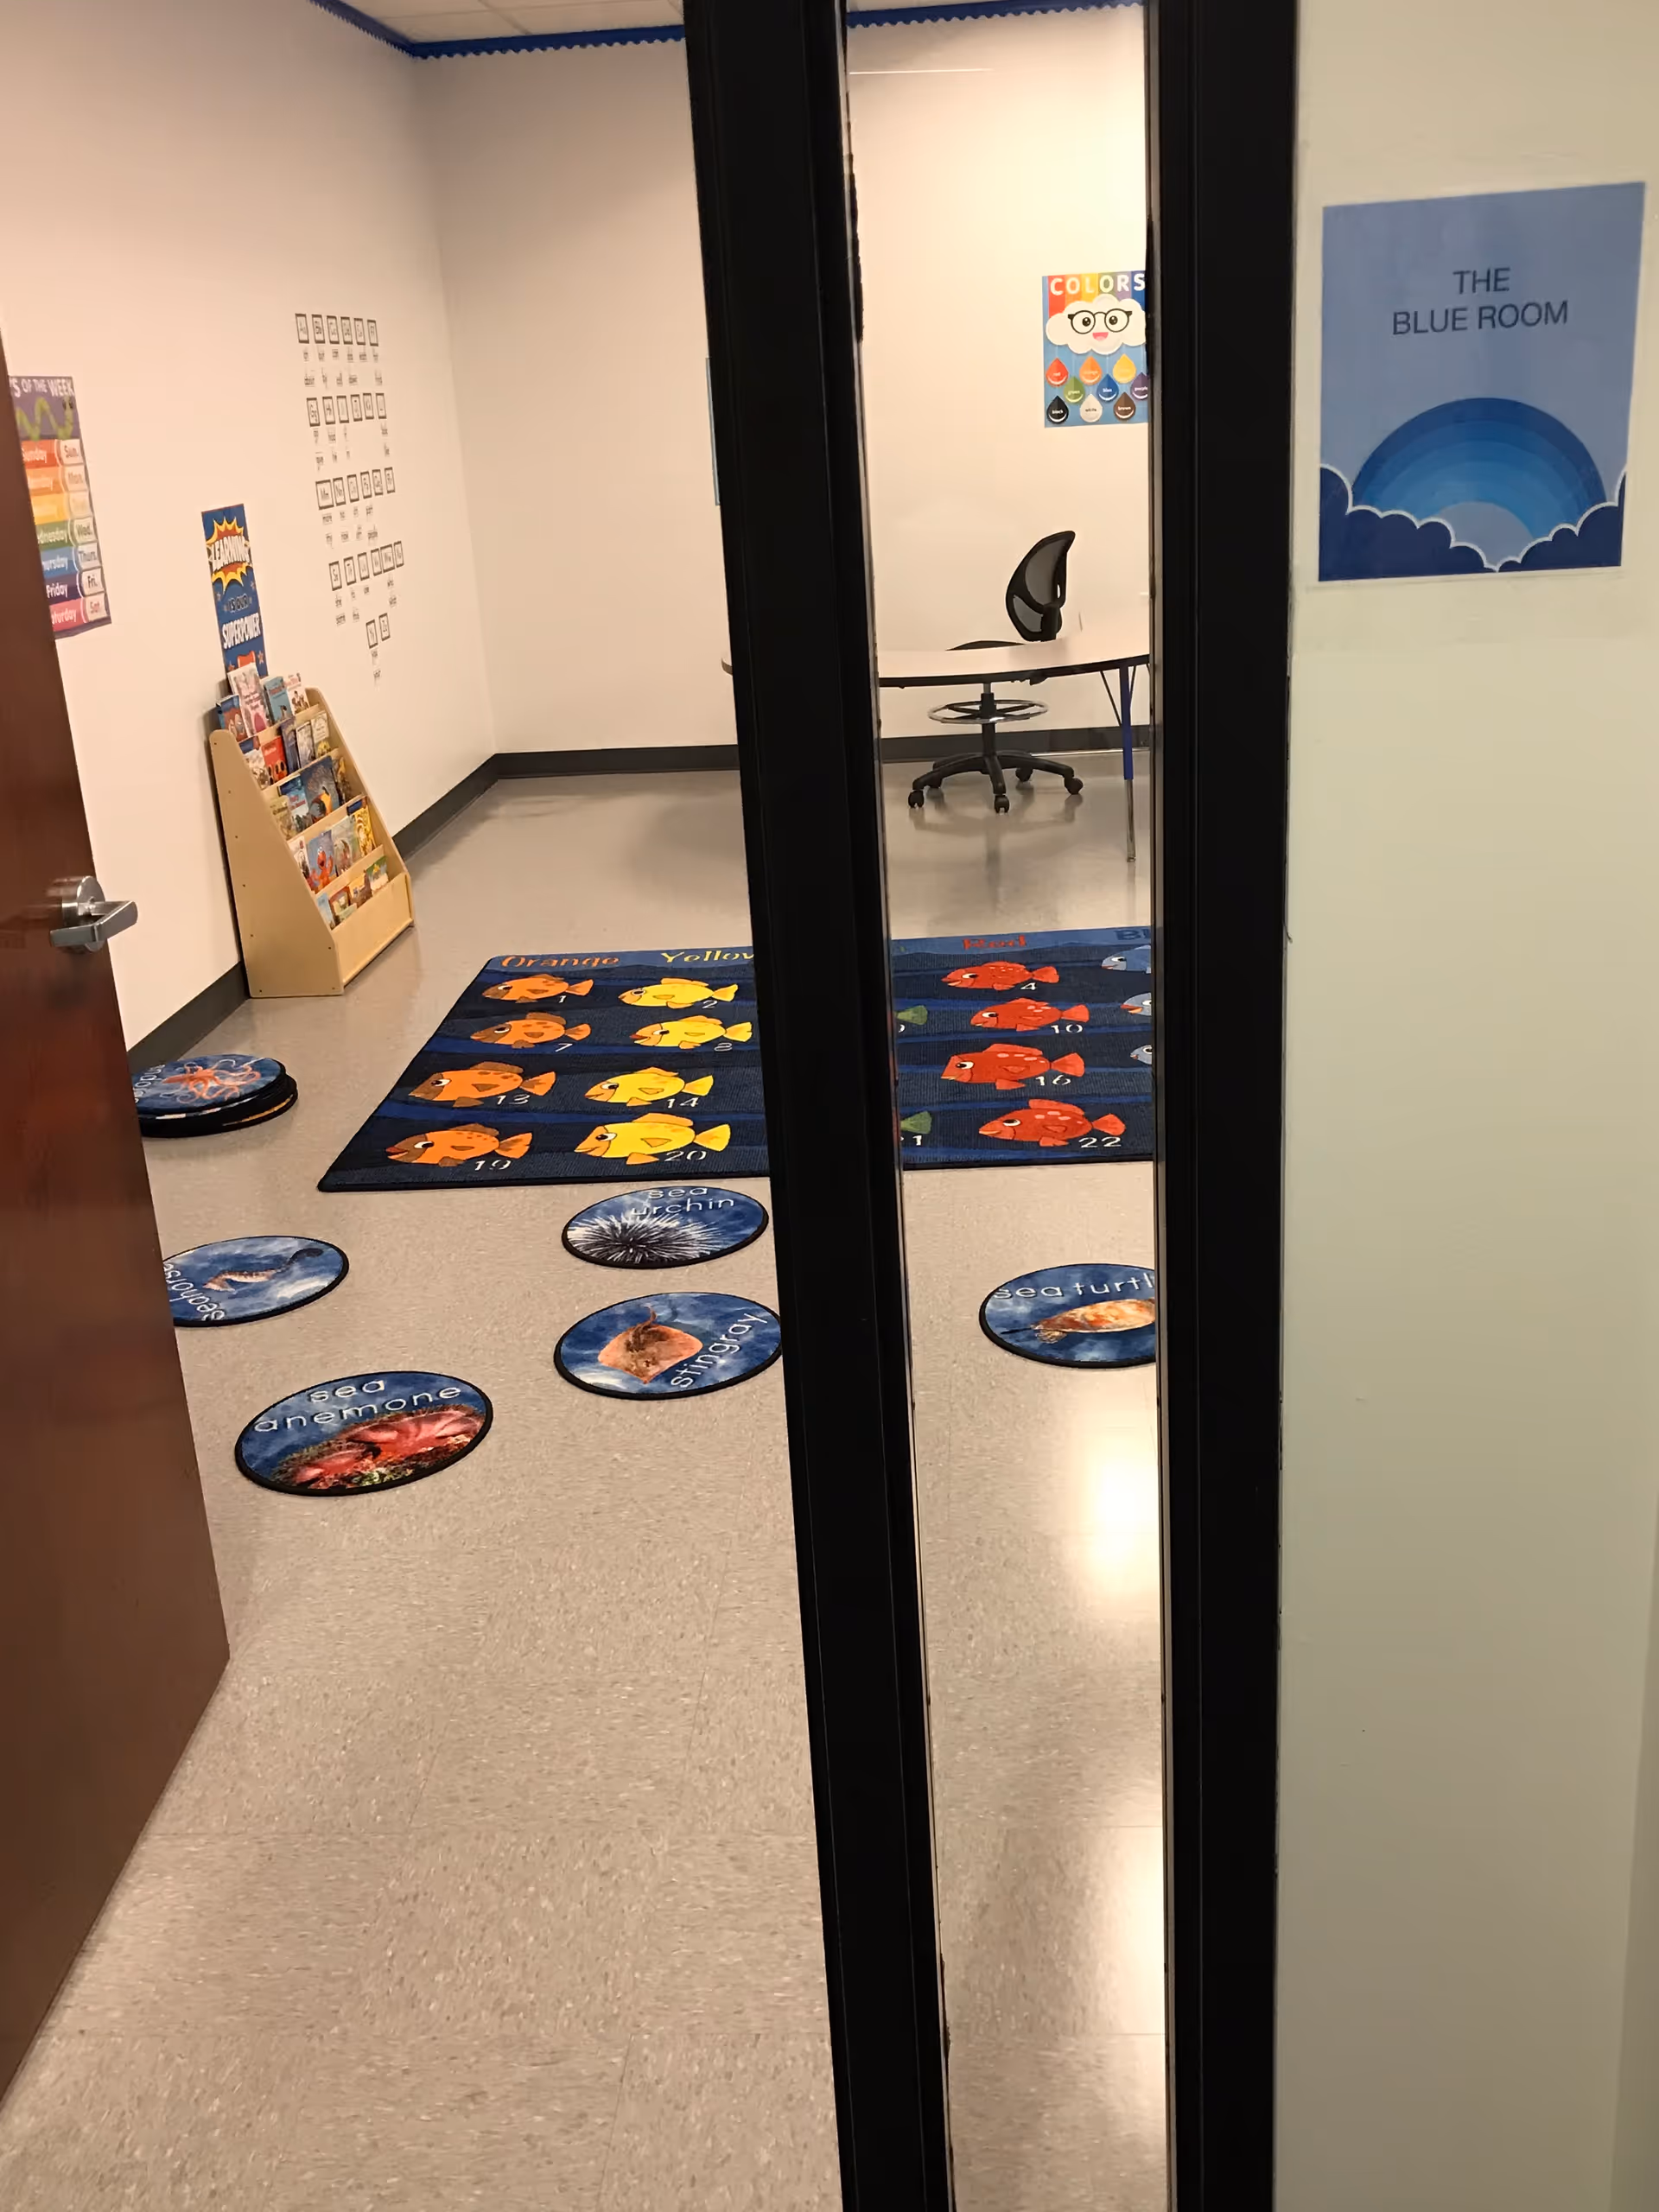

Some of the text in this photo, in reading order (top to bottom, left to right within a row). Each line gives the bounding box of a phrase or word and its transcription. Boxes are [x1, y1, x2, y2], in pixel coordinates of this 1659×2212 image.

[1050, 273, 1145, 296] COLORS
[1452, 267, 1510, 294] THE
[1392, 299, 1568, 335] BLUE ROOM
[48, 378, 75, 397] WEEK
[211, 535, 251, 573] LEARNING
[46, 582, 68, 598] Friday
[236, 594, 249, 611] OUR
[222, 612, 261, 650] SUPERPOWER
[962, 934, 1027, 950] Red
[499, 954, 620, 968] Orange
[1020, 982, 1037, 991] 4
[557, 995, 567, 1004] 1
[702, 999, 718, 1009] 2
[1051, 1024, 1083, 1033] 10
[554, 1042, 573, 1052] 7
[714, 1042, 733, 1052] 8
[1035, 1074, 1071, 1086] 16
[495, 1094, 531, 1106] 13
[665, 1096, 700, 1109] 14
[1078, 1136, 1122, 1148] 22
[664, 1149, 707, 1162] 20
[474, 1158, 512, 1172] 19
[648, 1186, 709, 1200] sea
[630, 1198, 734, 1217] urchin
[993, 1272, 1155, 1300] sea turtl
[671, 1313, 768, 1389] stingray
[310, 1379, 385, 1403] sea
[253, 1386, 461, 1433] anemone
